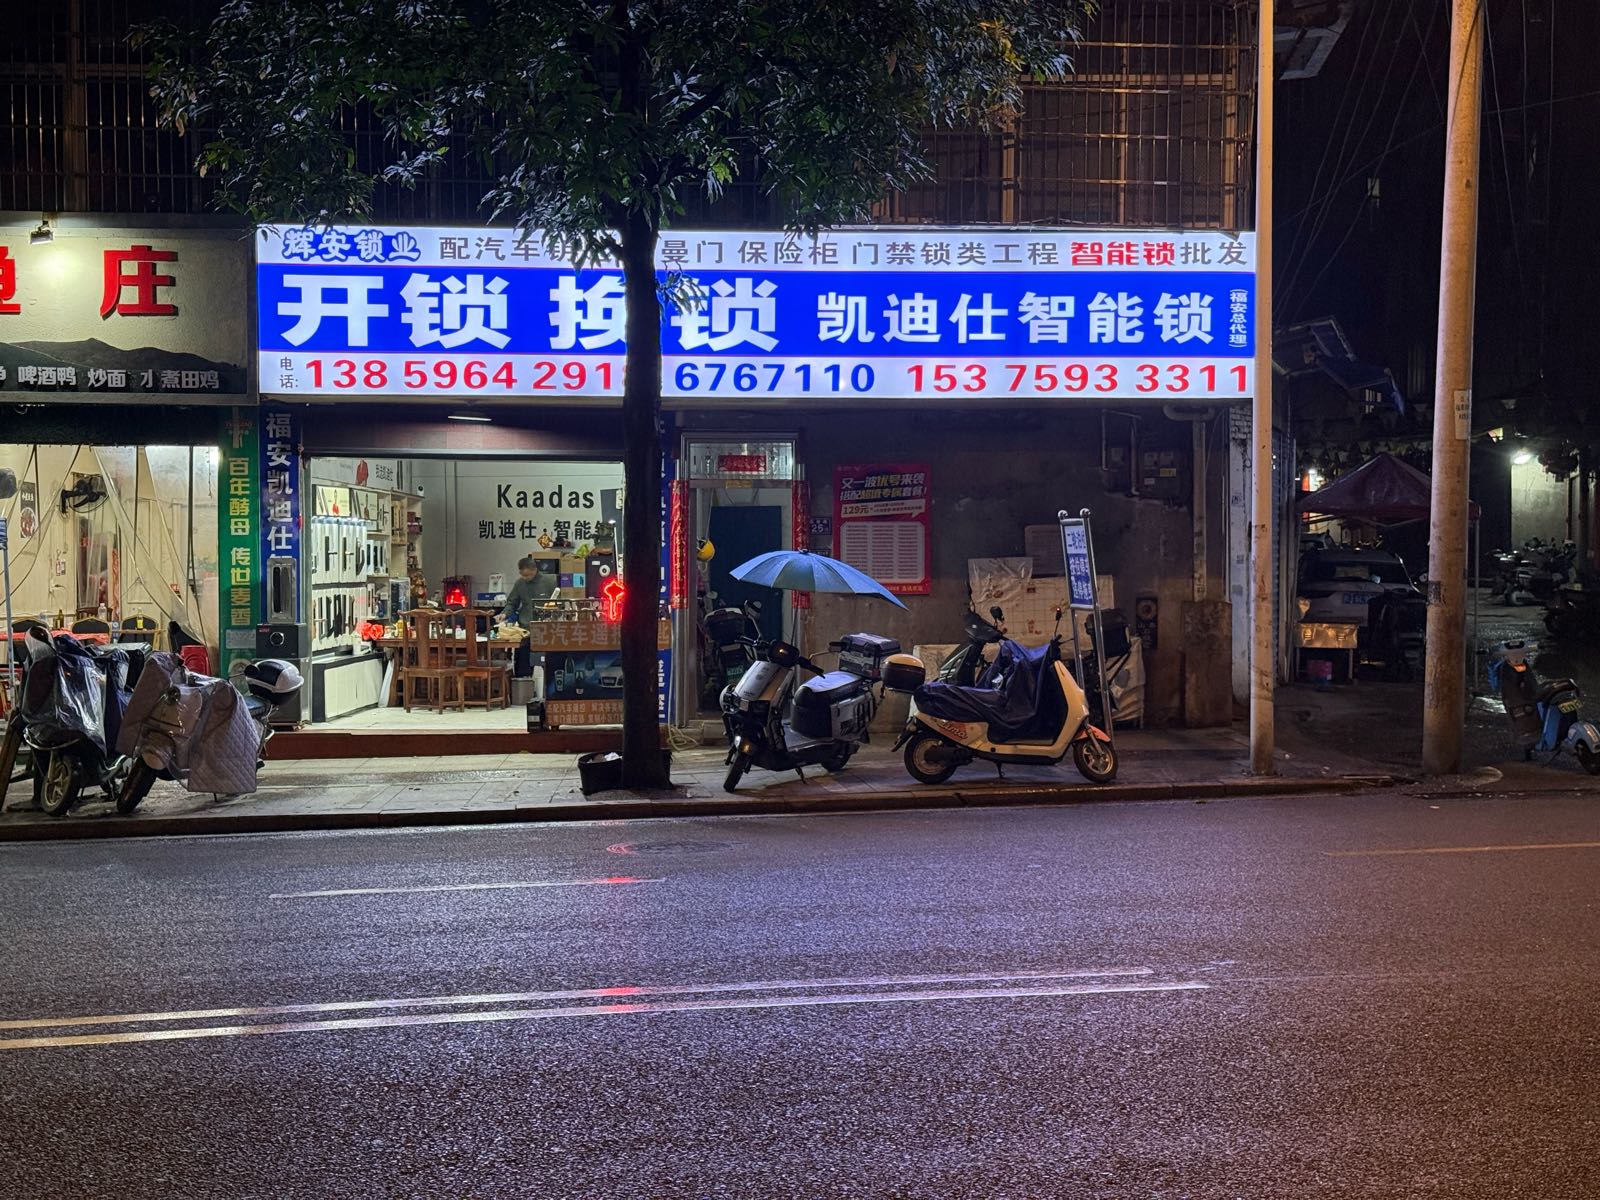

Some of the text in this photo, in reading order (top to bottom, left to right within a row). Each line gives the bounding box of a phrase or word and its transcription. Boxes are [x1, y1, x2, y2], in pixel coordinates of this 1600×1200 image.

[282, 228, 421, 263] 辉安锁业
[439, 236, 614, 263] 配汽车钥
[738, 240, 839, 265] 保险柜
[852, 241, 1059, 266] 门禁锁类工程
[277, 272, 512, 349] 开锁
[816, 291, 1215, 344] 凯迪仕智能锁
[18, 365, 77, 387] 啤酒鸭
[87, 369, 127, 389] 炒面
[305, 360, 1248, 393] 138 5964 291 6767110 153 7593 3311
[266, 412, 294, 560] 福安凯迪仕
[497, 484, 595, 509] Kaadas
